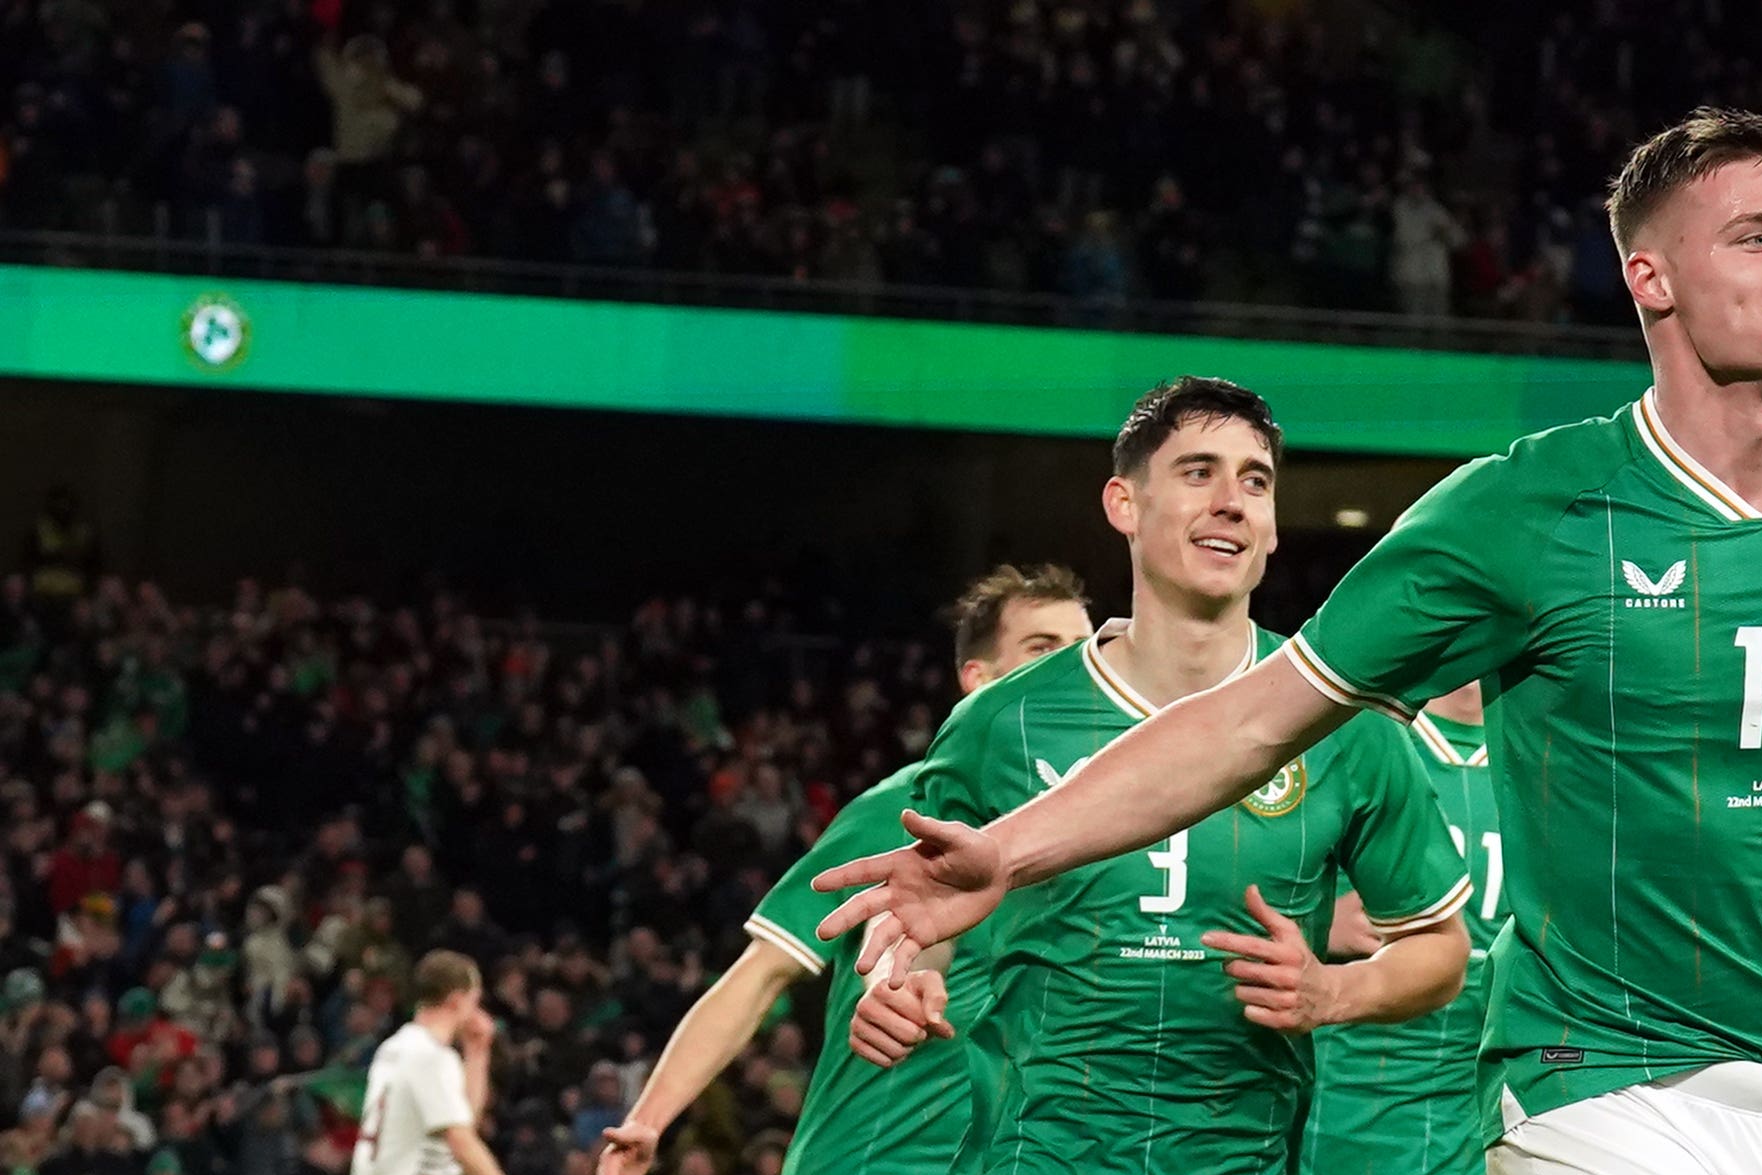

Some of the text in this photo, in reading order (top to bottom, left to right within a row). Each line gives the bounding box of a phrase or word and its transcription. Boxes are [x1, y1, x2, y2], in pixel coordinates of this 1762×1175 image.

[1625, 598, 1685, 608] CASTORE
[1727, 795, 1752, 808] 22nd
[1144, 936, 1181, 946] LATVIA
[1144, 948, 1181, 959] MARCH
